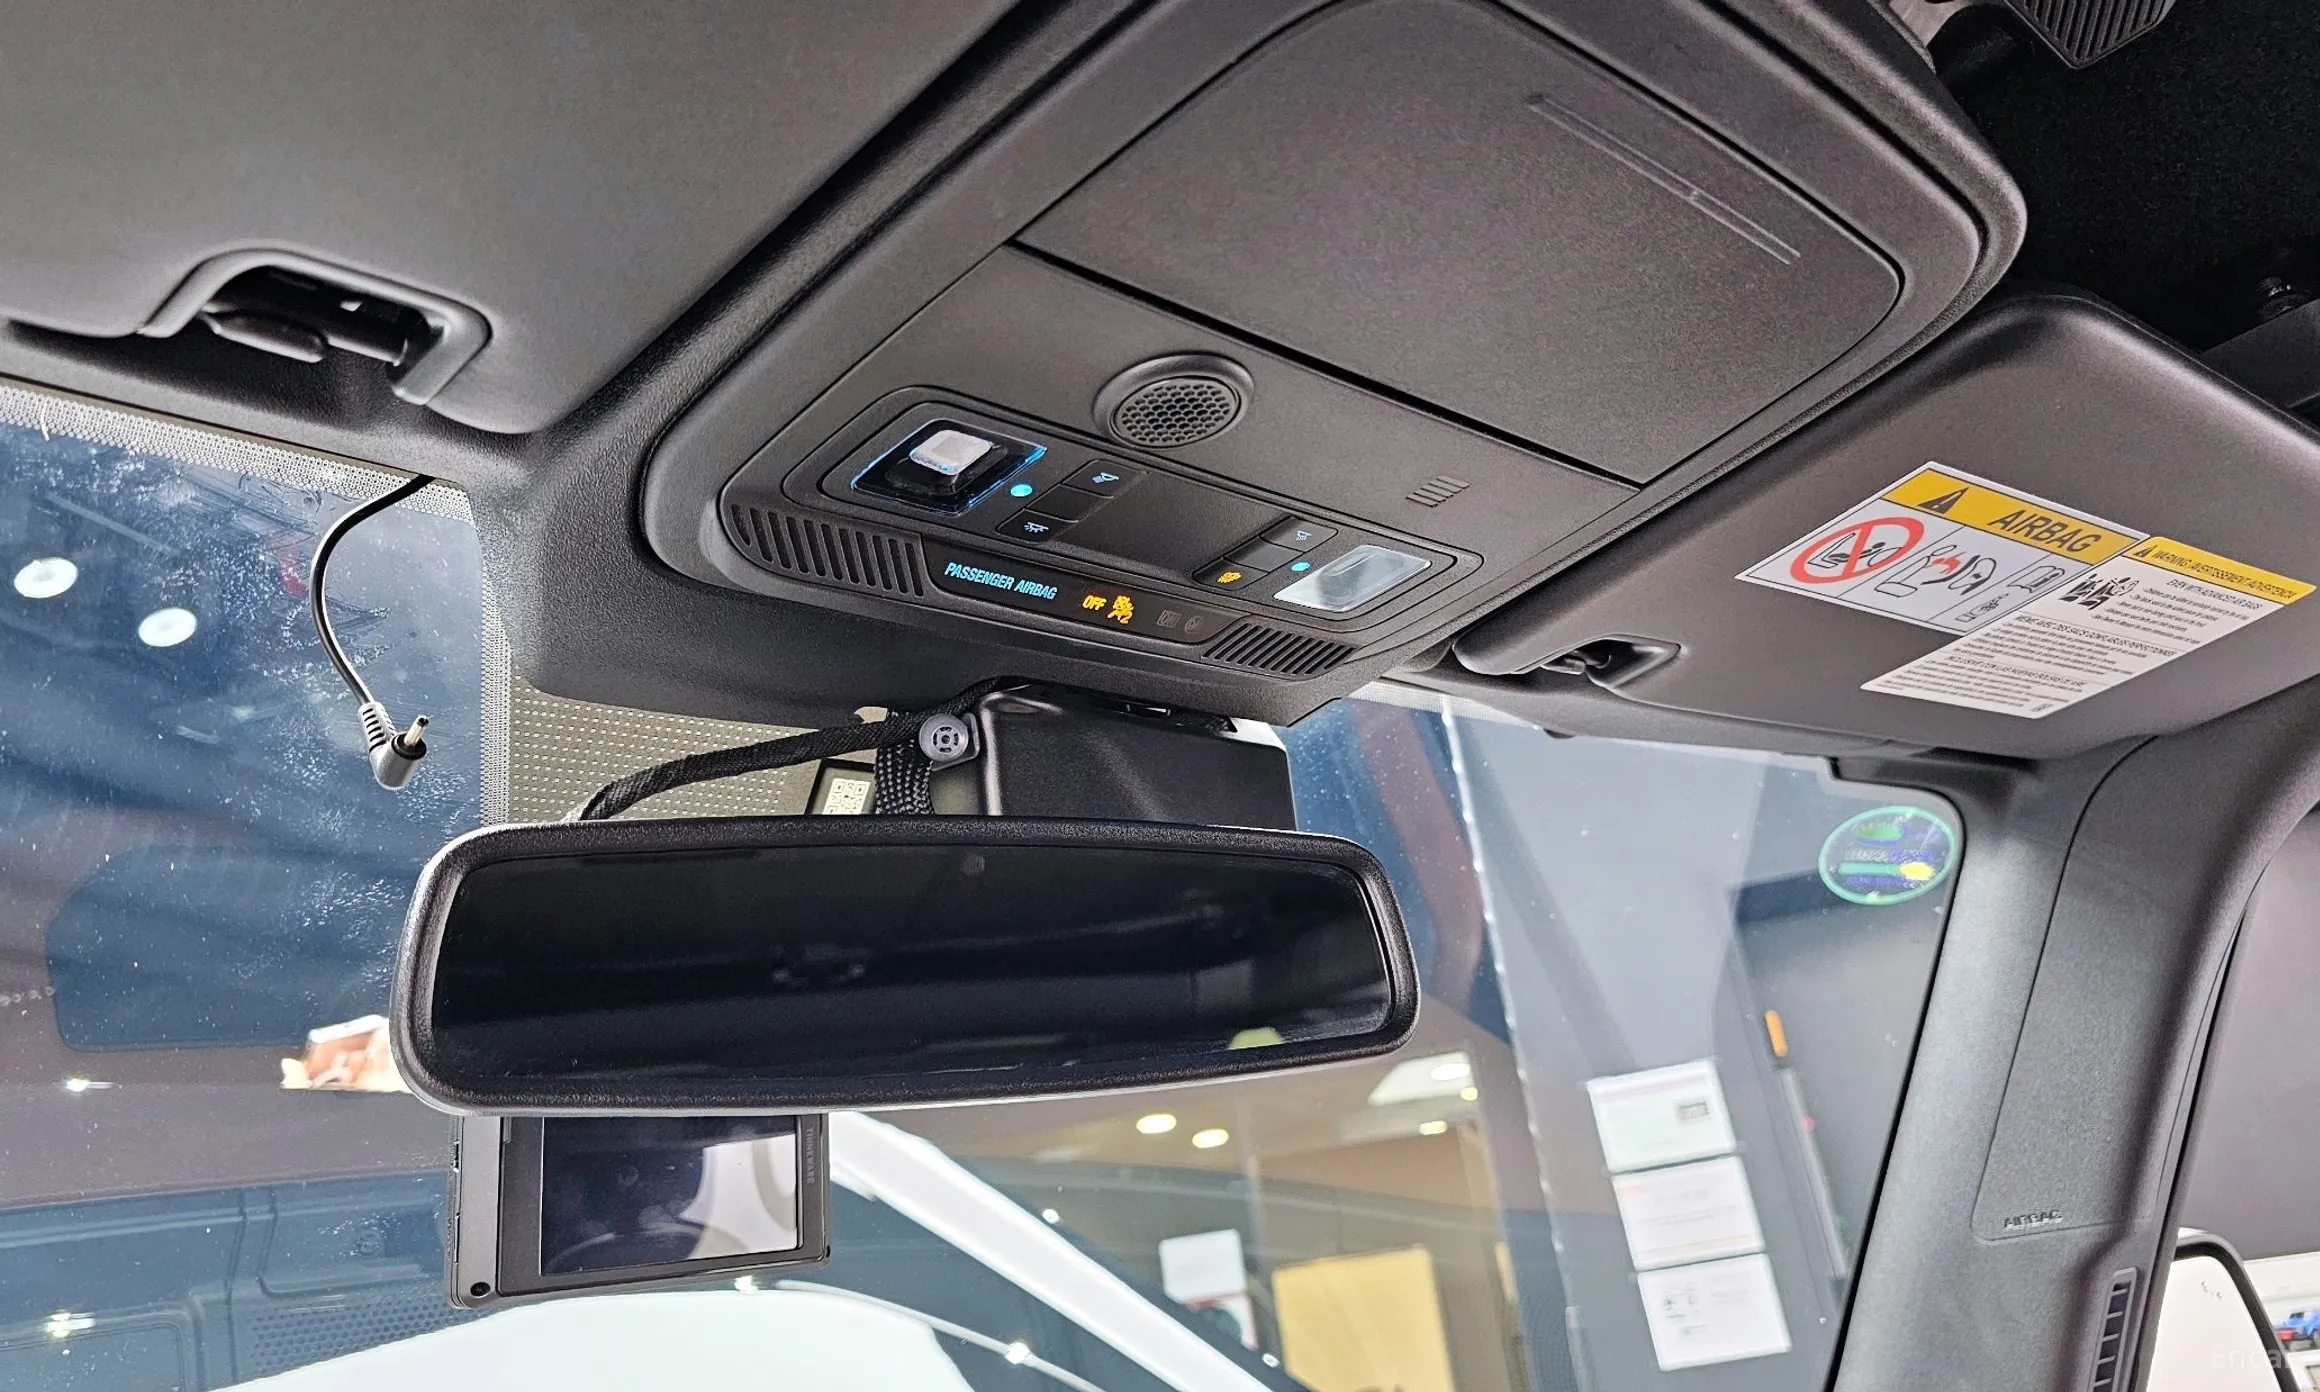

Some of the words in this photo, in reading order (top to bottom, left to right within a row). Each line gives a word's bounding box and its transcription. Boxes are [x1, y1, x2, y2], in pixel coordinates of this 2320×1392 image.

[1988, 510, 2100, 553] AIRBAG
[943, 562, 1014, 591] PASSENGER
[1014, 577, 1058, 600] AIRBAG
[1082, 595, 1106, 611] OFF
[805, 1128, 815, 1184] THINKWARE
